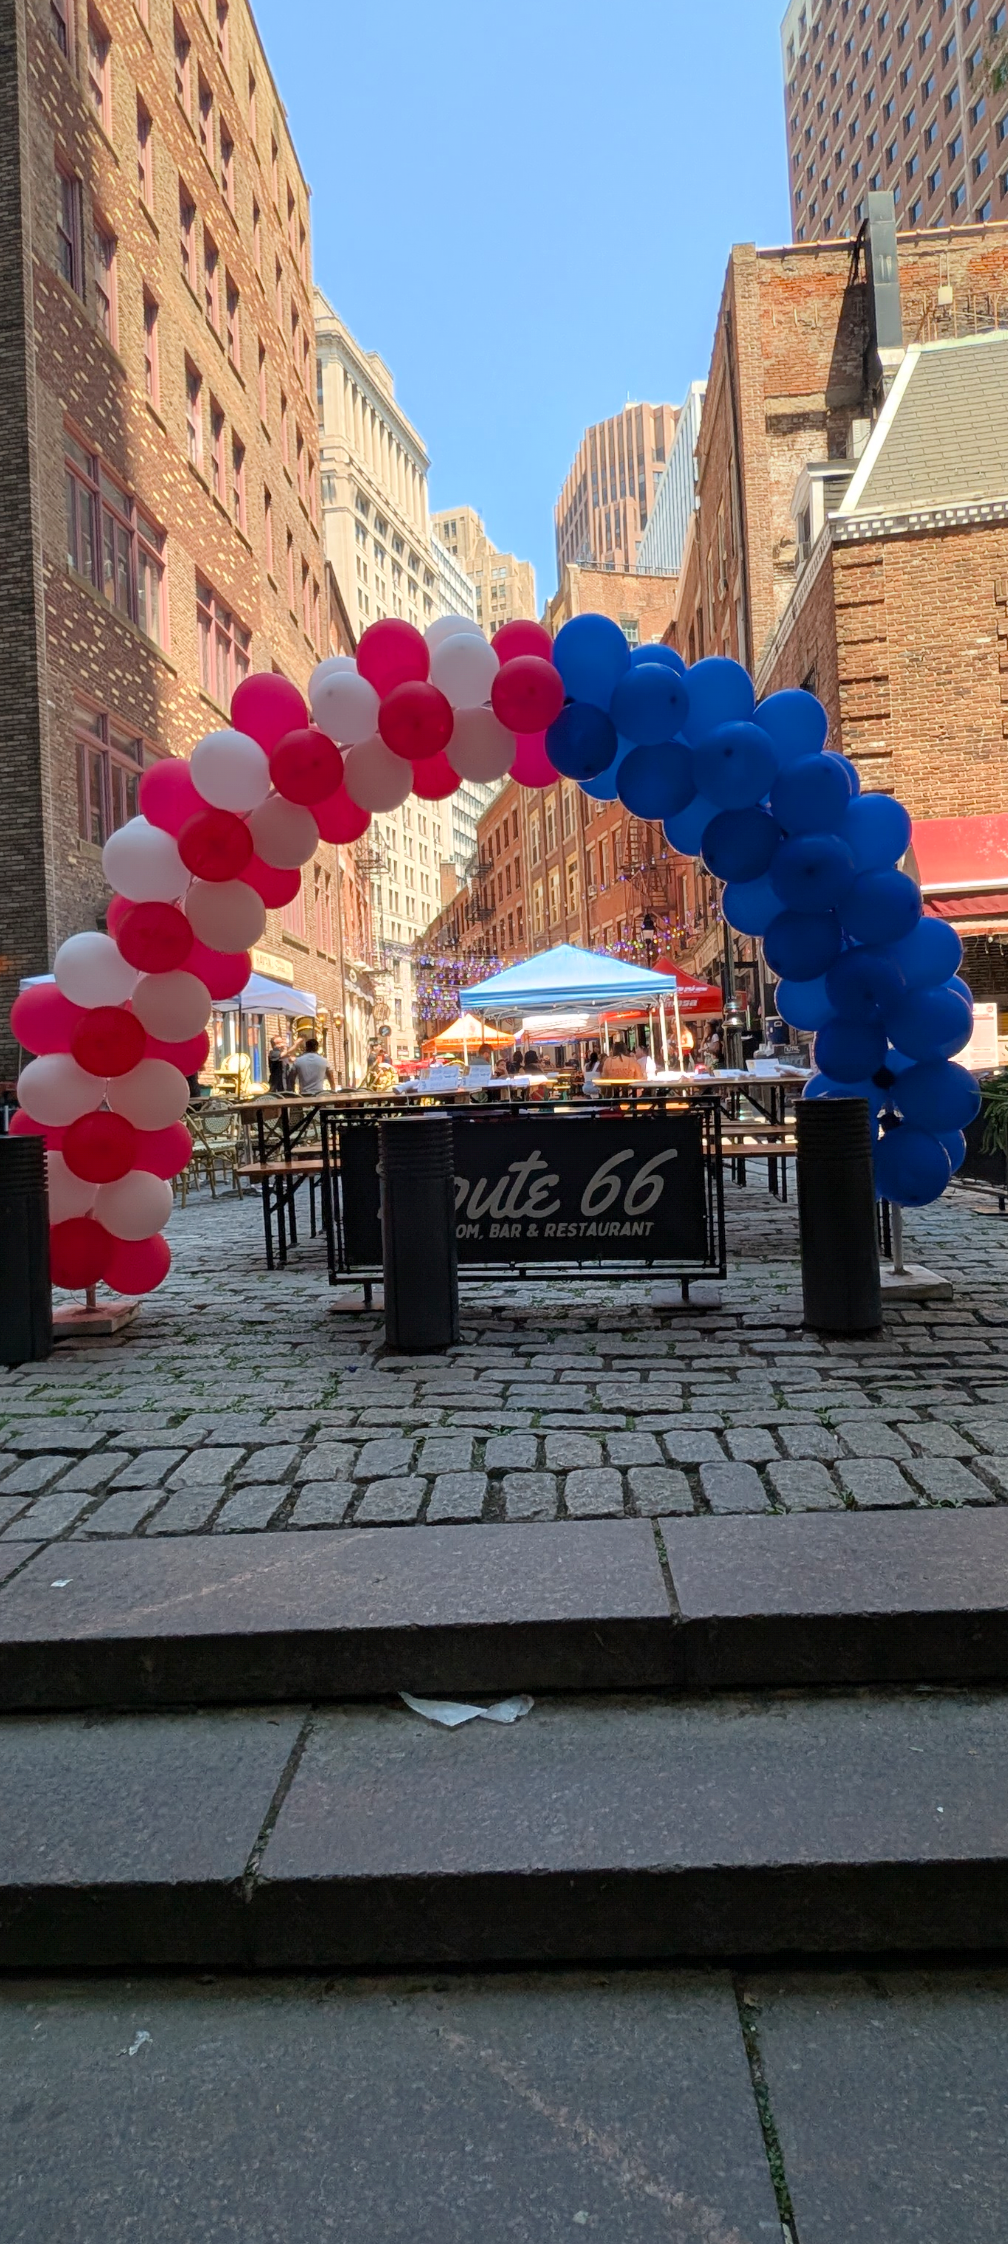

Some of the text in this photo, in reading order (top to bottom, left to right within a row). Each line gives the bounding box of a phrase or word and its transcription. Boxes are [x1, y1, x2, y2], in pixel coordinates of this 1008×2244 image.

[376, 1148, 678, 1220] oute 66
[455, 1221, 655, 1240] OM, BAR & RESTAURANT
